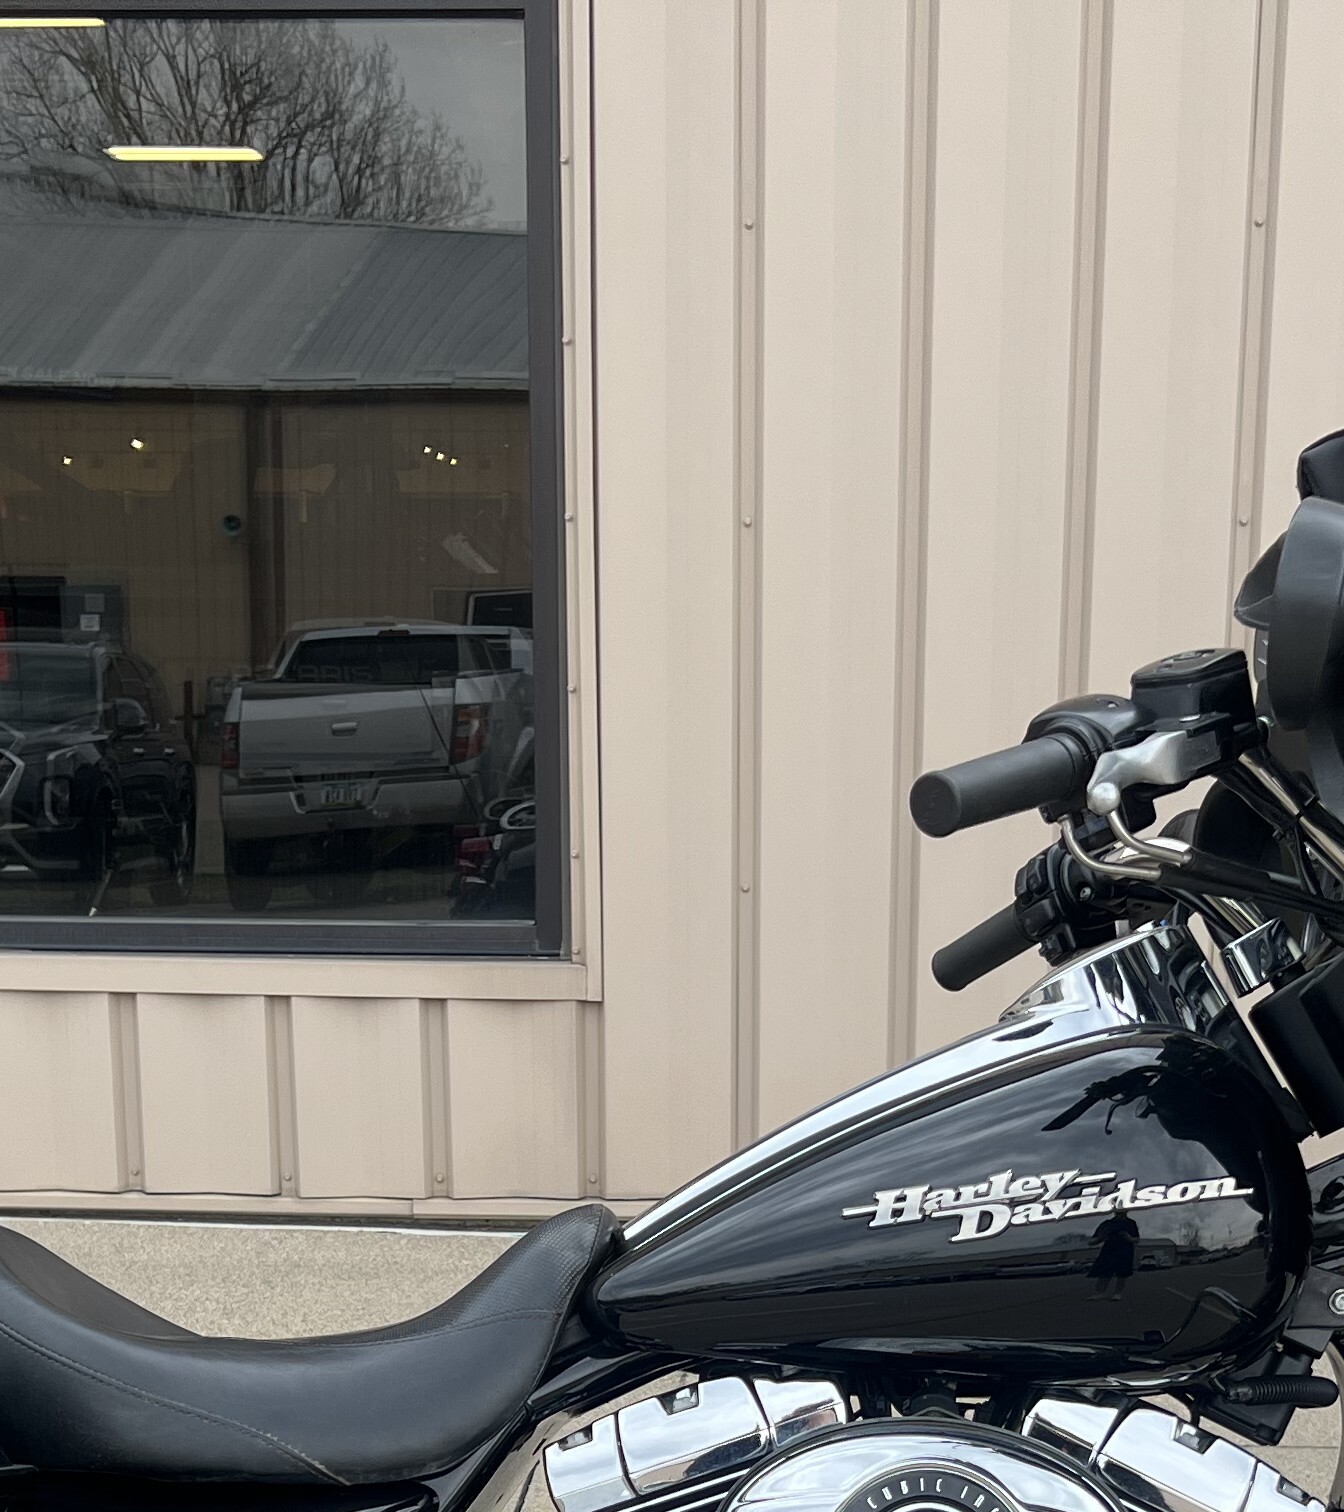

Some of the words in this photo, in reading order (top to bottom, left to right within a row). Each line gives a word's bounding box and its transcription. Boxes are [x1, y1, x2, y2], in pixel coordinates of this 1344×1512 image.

[842, 1168, 1116, 1228] Harley
[932, 1177, 1254, 1243] Davidson
[867, 1478, 943, 1510] CUBIC
